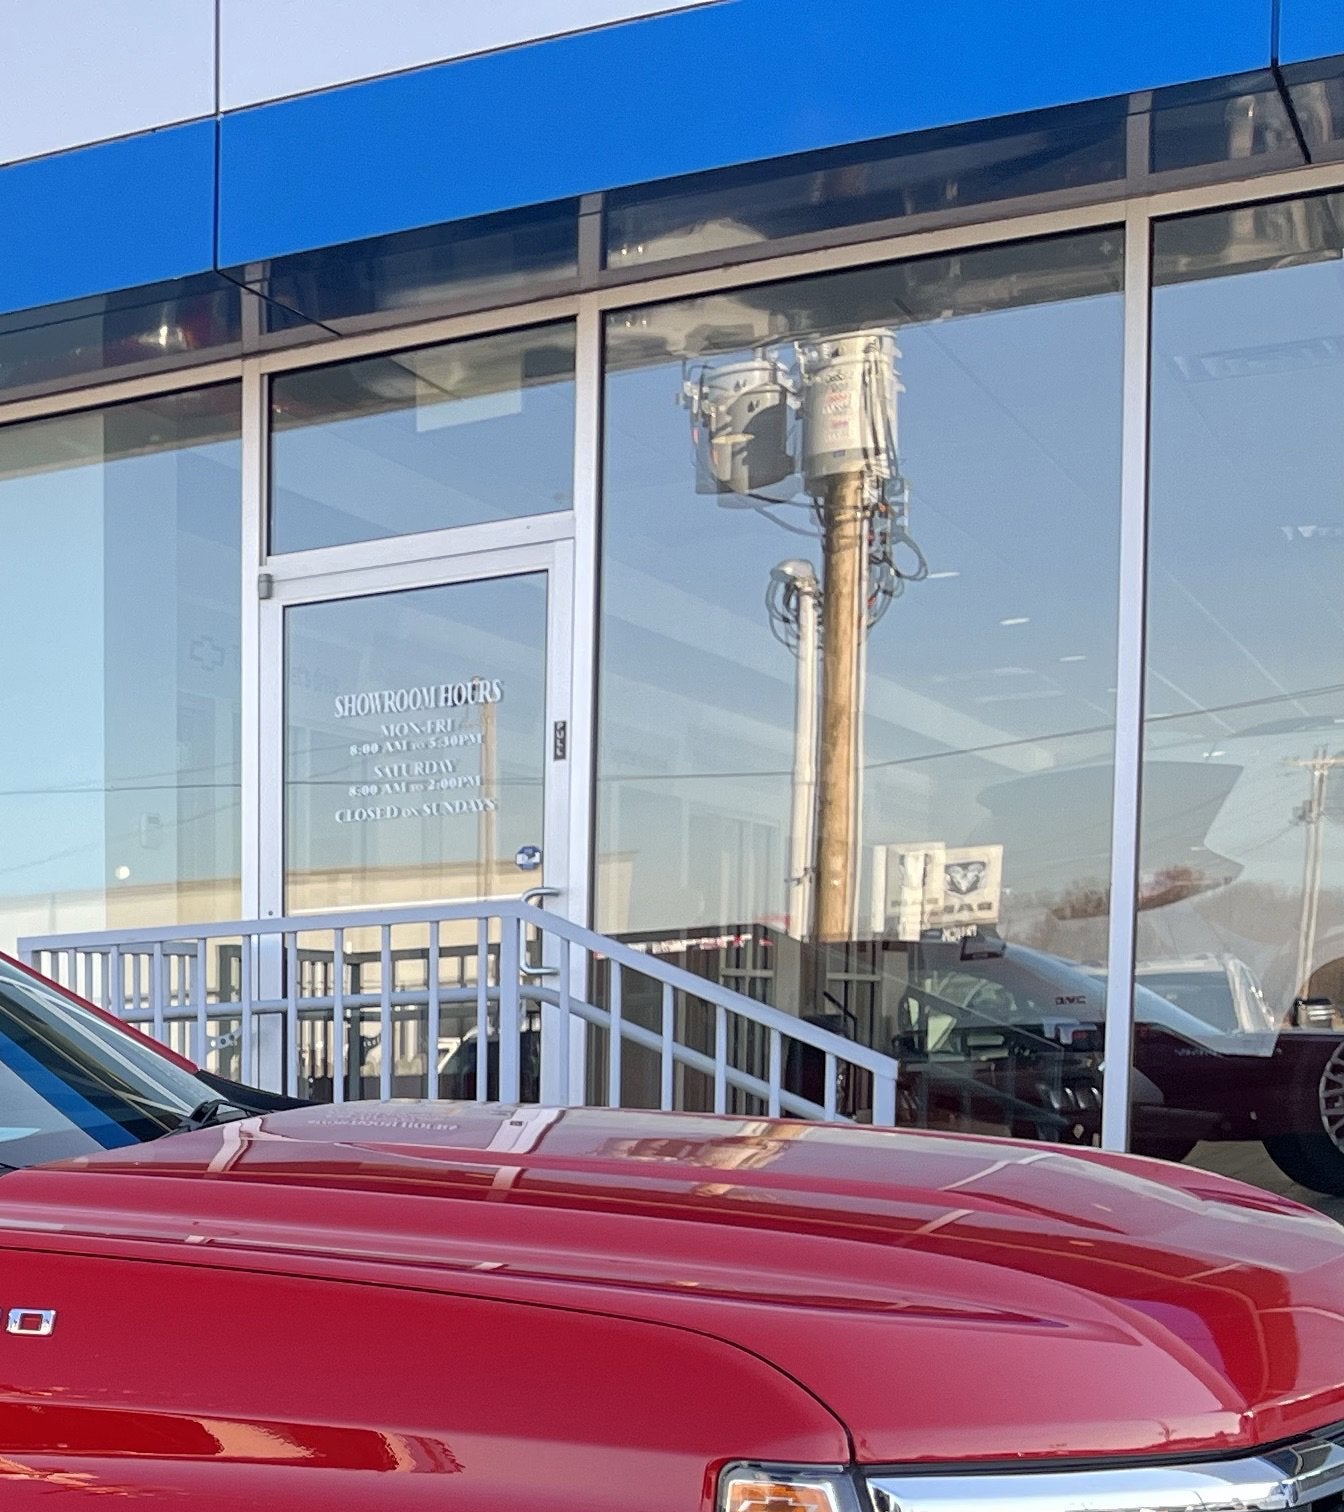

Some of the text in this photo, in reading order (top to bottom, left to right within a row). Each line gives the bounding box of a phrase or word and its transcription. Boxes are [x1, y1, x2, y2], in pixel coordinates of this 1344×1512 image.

[334, 678, 503, 718] SHOWROOM HOURS
[380, 717, 453, 737] MON-FRI
[349, 742, 379, 756] 8:00
[381, 740, 408, 753] AM
[373, 759, 456, 779] SATURDAY
[348, 784, 379, 798] 8:00
[381, 781, 407, 795] AM
[427, 774, 482, 791] 2:00PM
[334, 804, 400, 824] CLOSED
[422, 798, 497, 817] SUNDAYS
